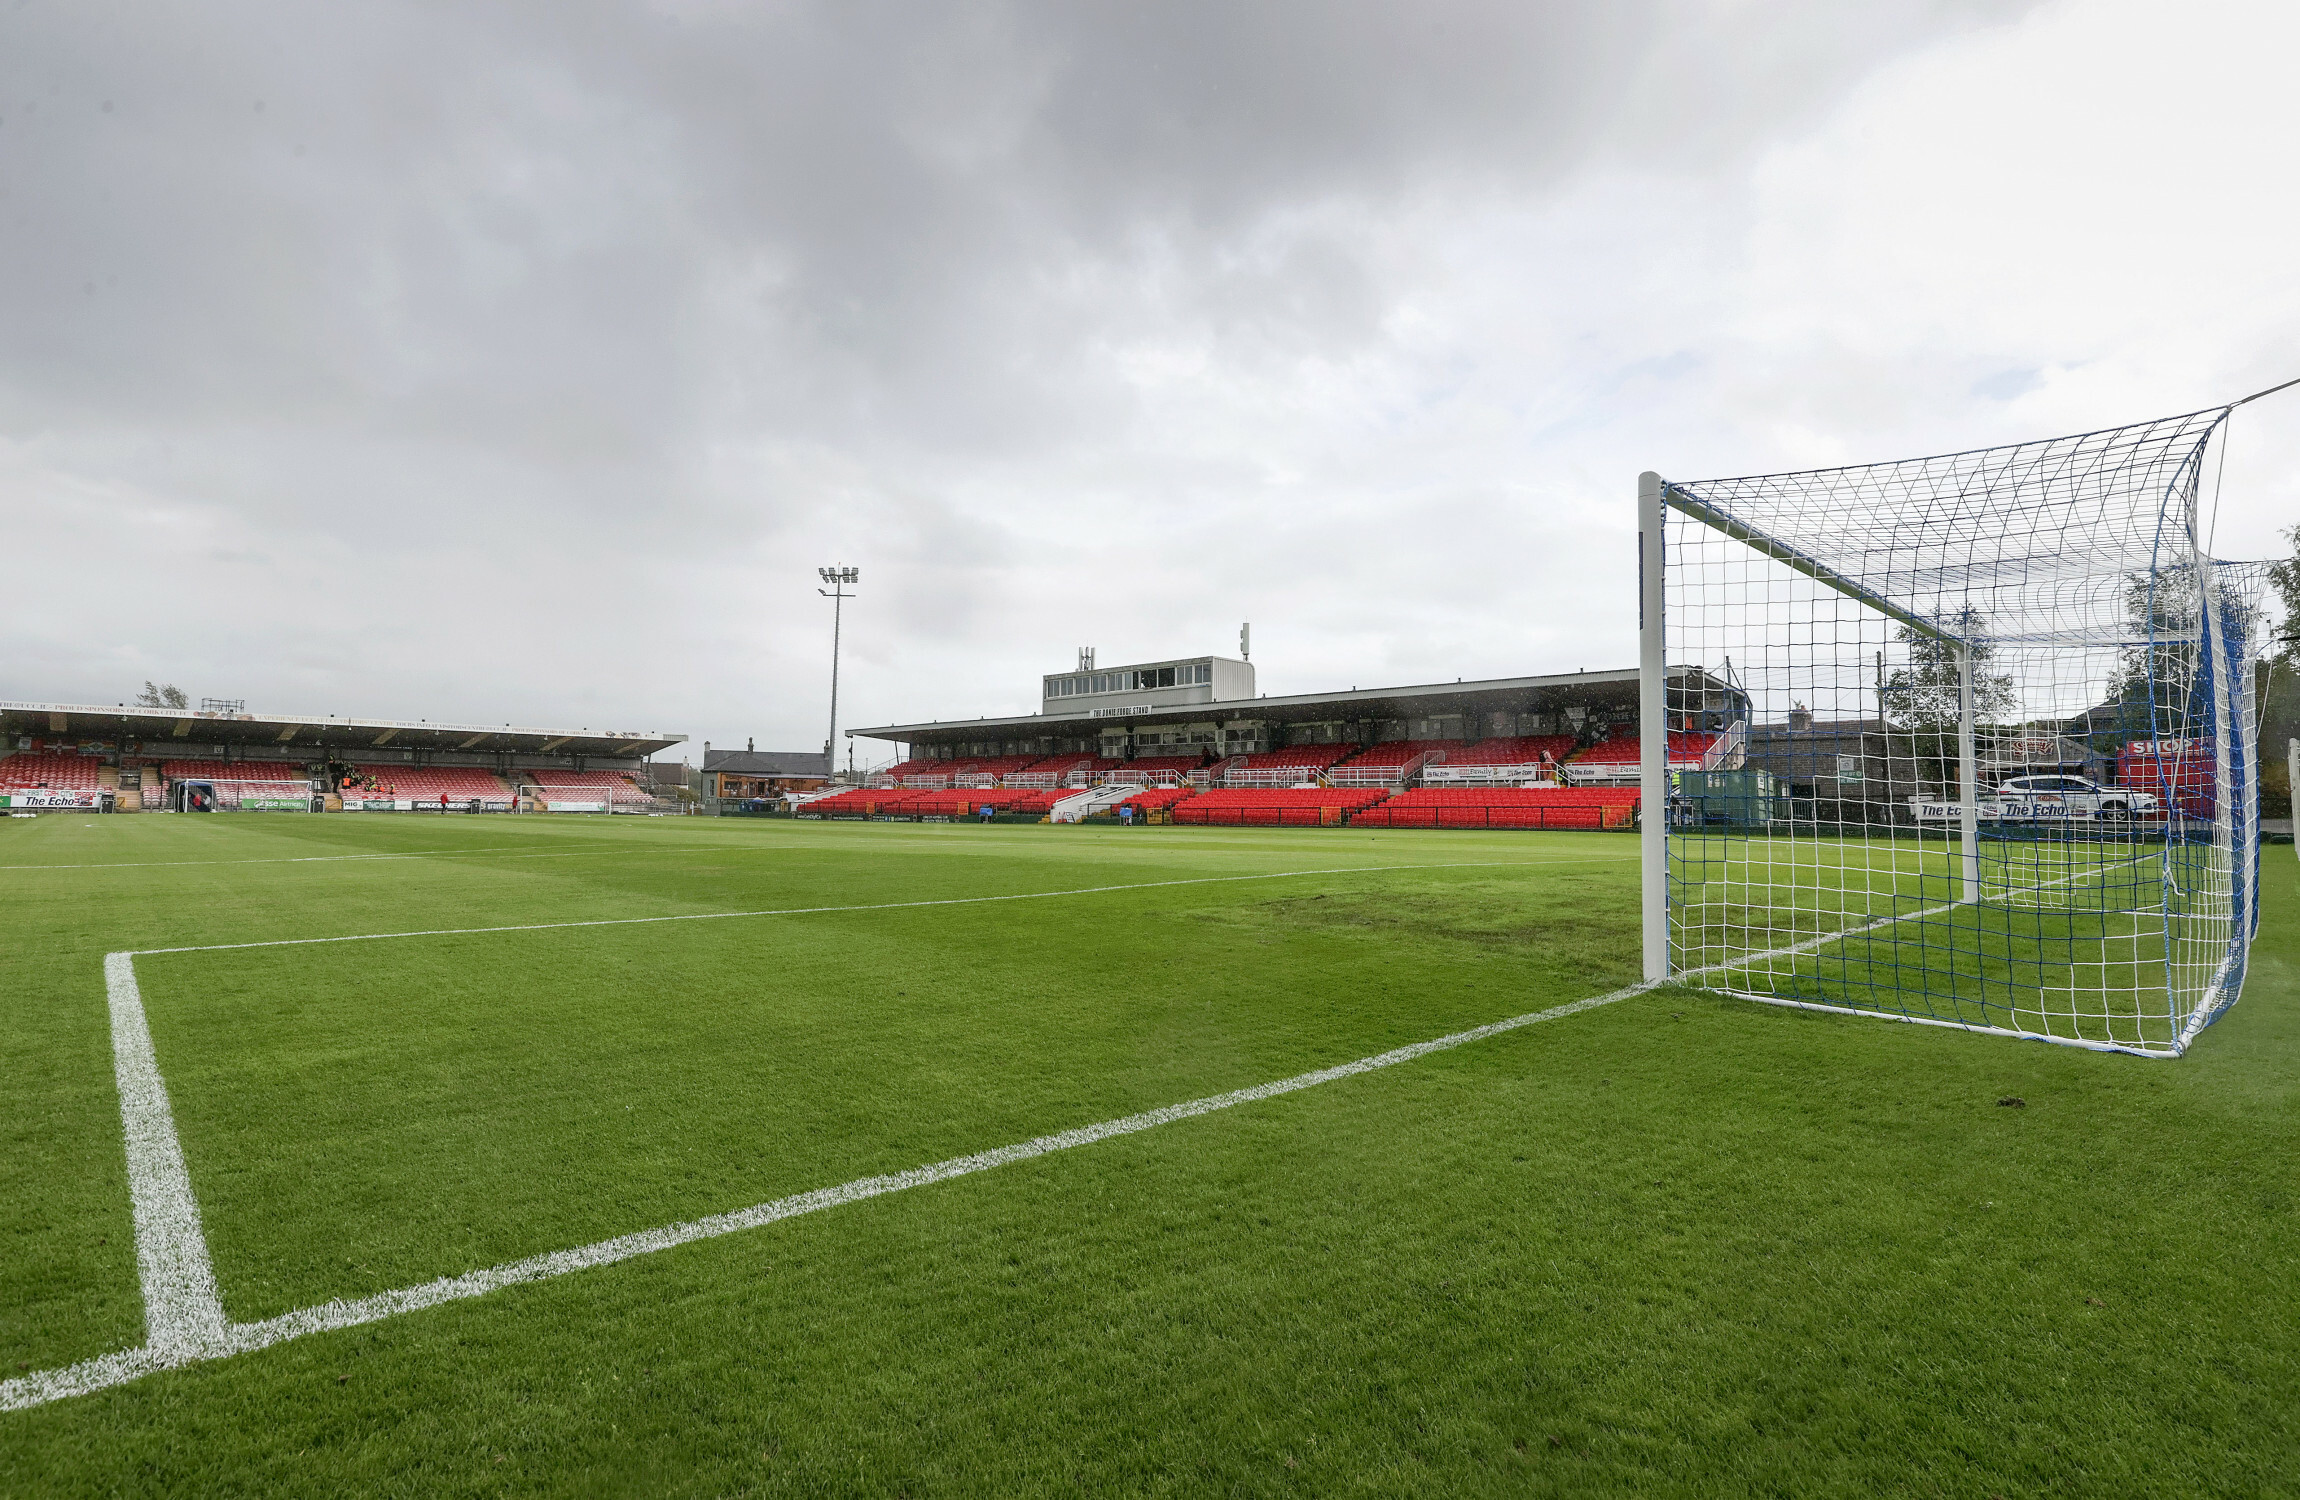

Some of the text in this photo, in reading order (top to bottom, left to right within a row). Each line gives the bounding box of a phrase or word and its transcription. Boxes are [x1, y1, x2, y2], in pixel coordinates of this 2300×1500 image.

[84, 706, 125, 714] SPONSORS
[1132, 706, 1149, 715] STAND
[2132, 739, 2193, 754] SHOP
[26, 796, 75, 806] The Echo
[1922, 805, 1962, 816] The Ec
[2005, 803, 2029, 816] The
[2033, 803, 2066, 816] Echo
